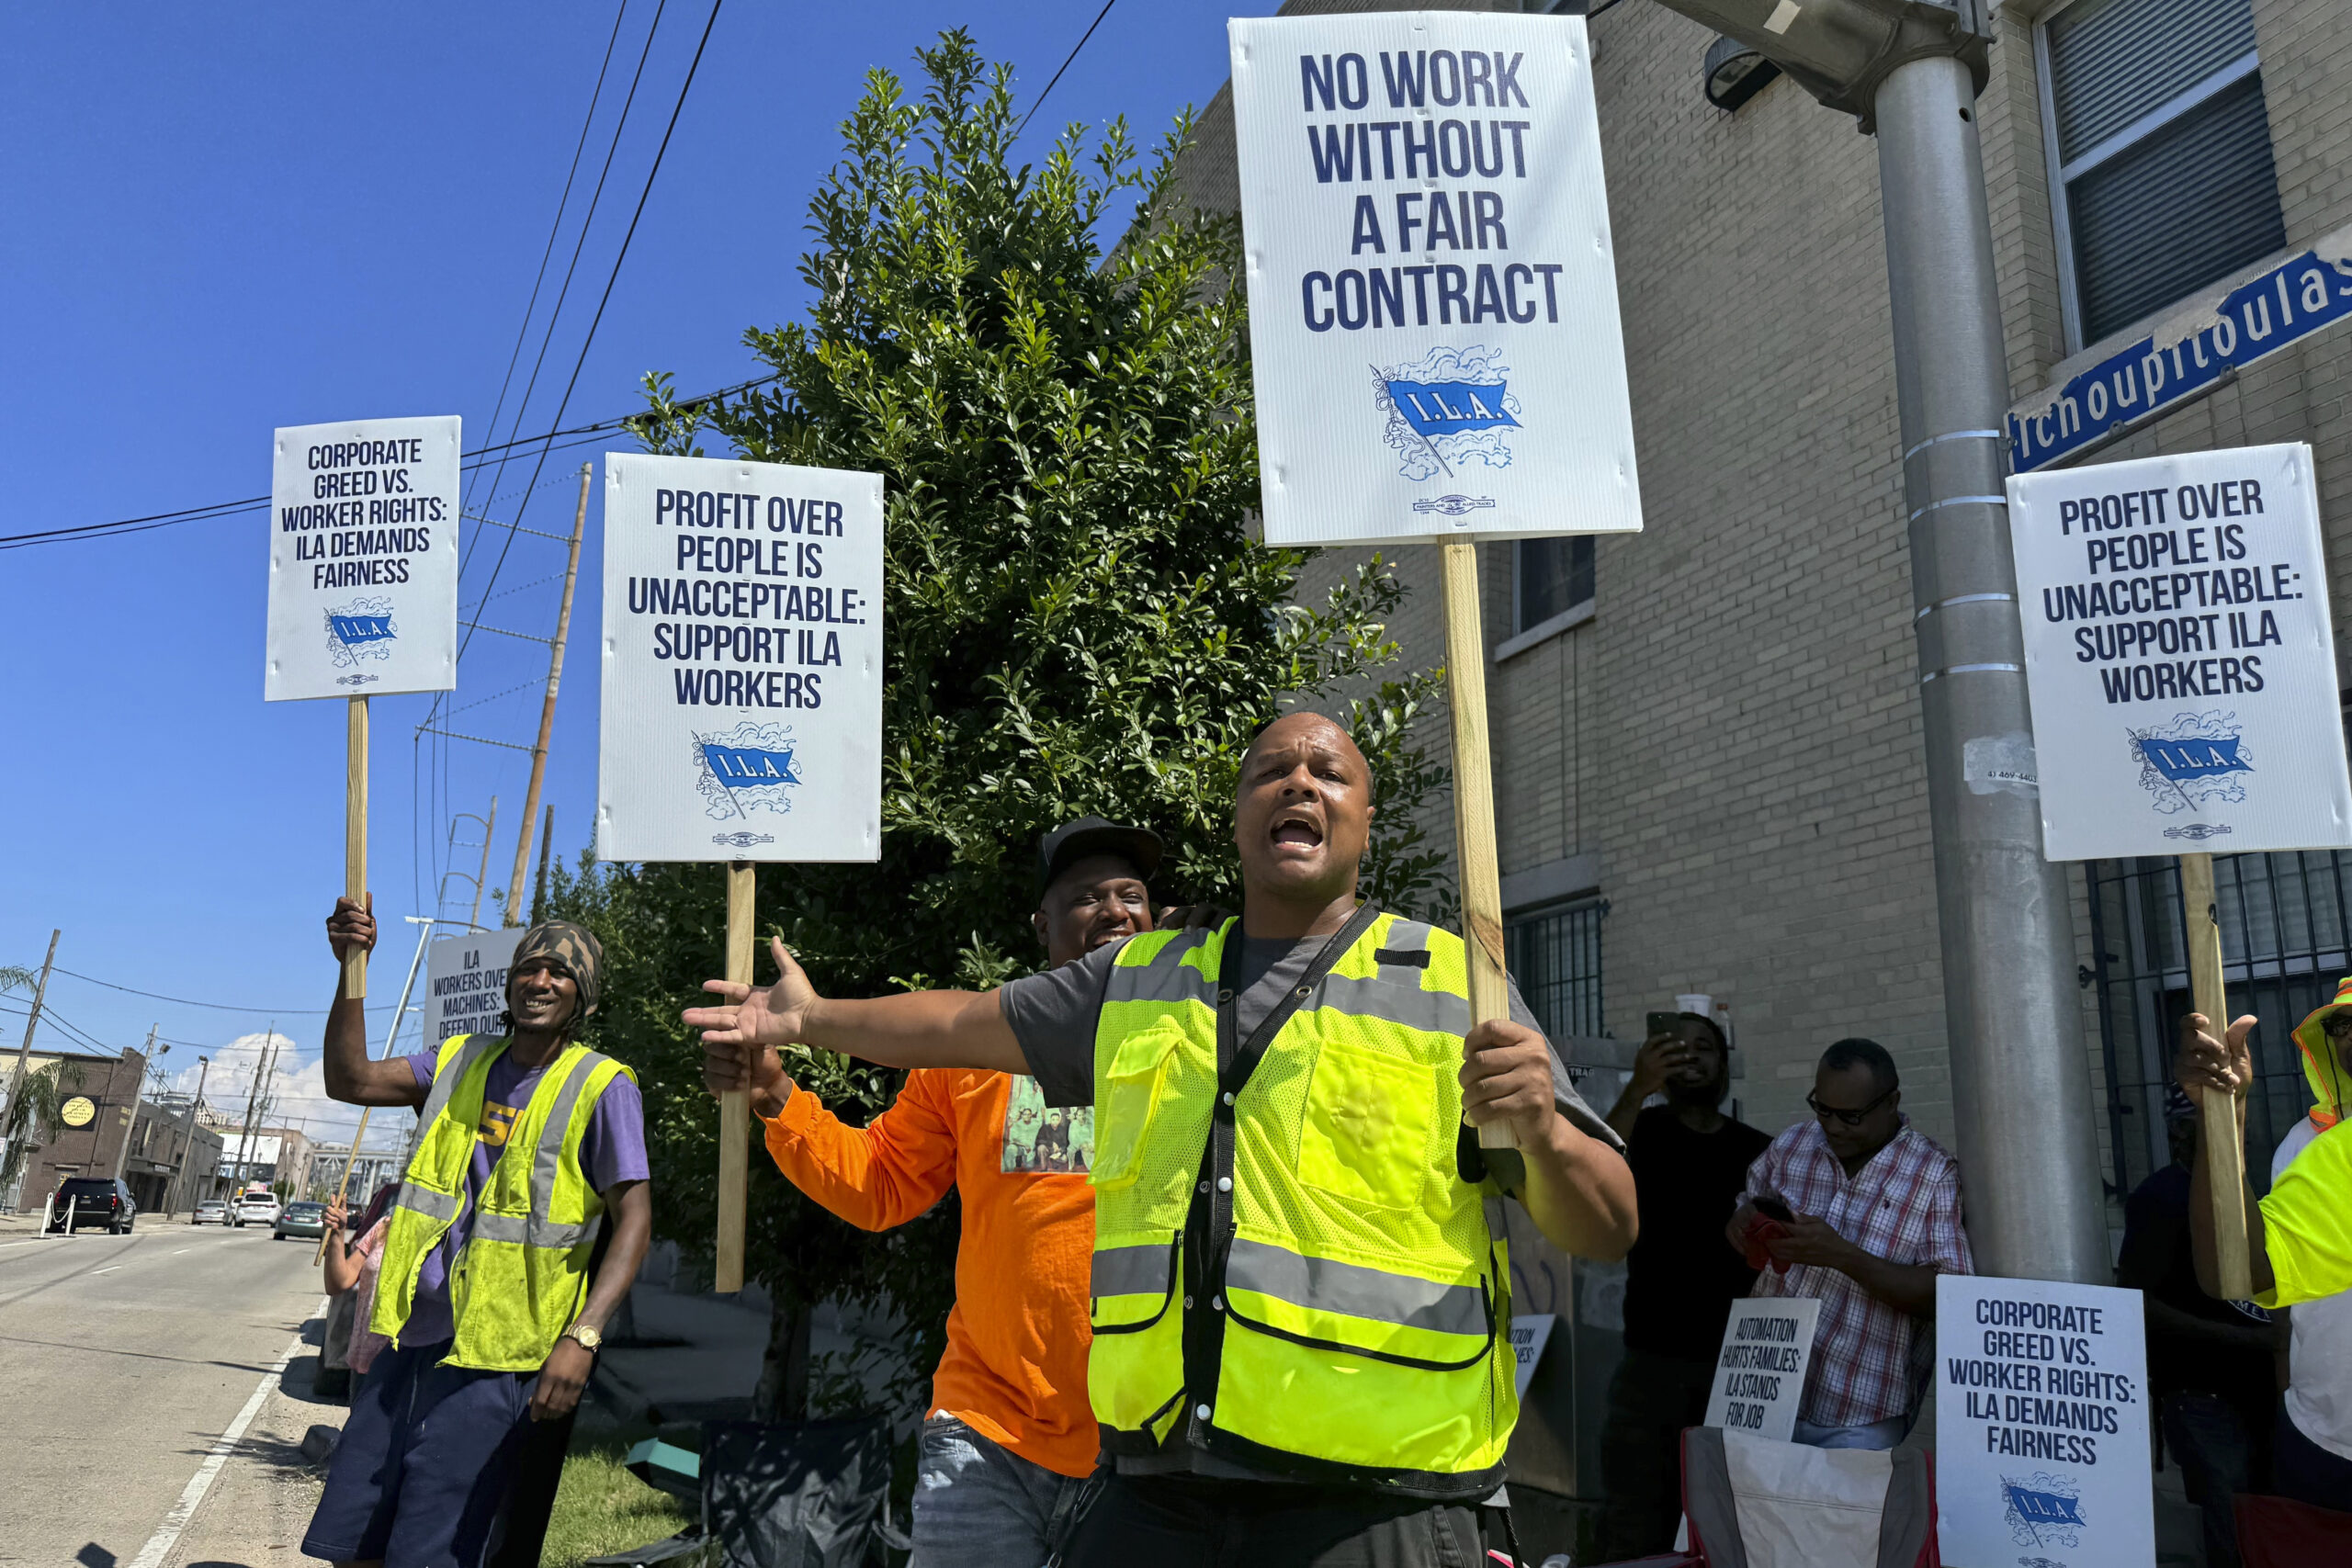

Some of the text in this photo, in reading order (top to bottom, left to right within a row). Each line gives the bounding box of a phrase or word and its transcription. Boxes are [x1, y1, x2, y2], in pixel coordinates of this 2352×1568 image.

[1300, 50, 1529, 111] NO WORK
[1307, 119, 1530, 183] WITHOUT
[1351, 191, 1508, 254] A FAIR
[1302, 264, 1563, 332] CONTRACT
[1405, 391, 1504, 422] I.L.A.
[309, 439, 422, 470] CORPORATE
[314, 469, 413, 499] GREED VS.
[282, 497, 447, 532] WORKER RIGHTS:
[657, 490, 842, 536] PROFIT OVER
[2060, 479, 2264, 535] PROFIT OVER
[297, 527, 429, 560] ILA DEMANDS
[678, 535, 822, 579] PEOPLE IS
[2087, 525, 2245, 574] PEOPLE IS
[314, 558, 409, 589] FAIRNESS
[629, 577, 865, 624] UNACCEPTABLE:
[2043, 564, 2302, 622] UNACCEPTABLE:
[340, 620, 388, 637] I.L.A.
[654, 623, 842, 666] SUPPORT ILA
[2075, 610, 2281, 662] SUPPORT ILA
[674, 669, 820, 708] WORKERS
[2100, 656, 2264, 704] WORKERS
[716, 754, 788, 778] I.L.A.
[2157, 746, 2237, 769] I.L.A.
[464, 950, 480, 970] ILA
[434, 967, 509, 997] WORKERS OVE
[443, 992, 500, 1017] MACHINES:
[439, 1016, 477, 1040] DEFEND
[1735, 1317, 1798, 1342] AUTOMATION
[1976, 1299, 2103, 1335] CORPORATE
[1721, 1345, 1801, 1373] HURTS FAMILIES:
[1984, 1330, 2096, 1367] GREED VS.
[1724, 1372, 1781, 1401] ILA STANDS
[1949, 1359, 2136, 1404] WORKER RIGHTS:
[1725, 1402, 1764, 1429] FOR JOB
[1967, 1392, 2118, 1434] ILA DEMANDS
[1988, 1426, 2096, 1465] FAIRNESS
[2021, 1495, 2075, 1518] I.L.A.
